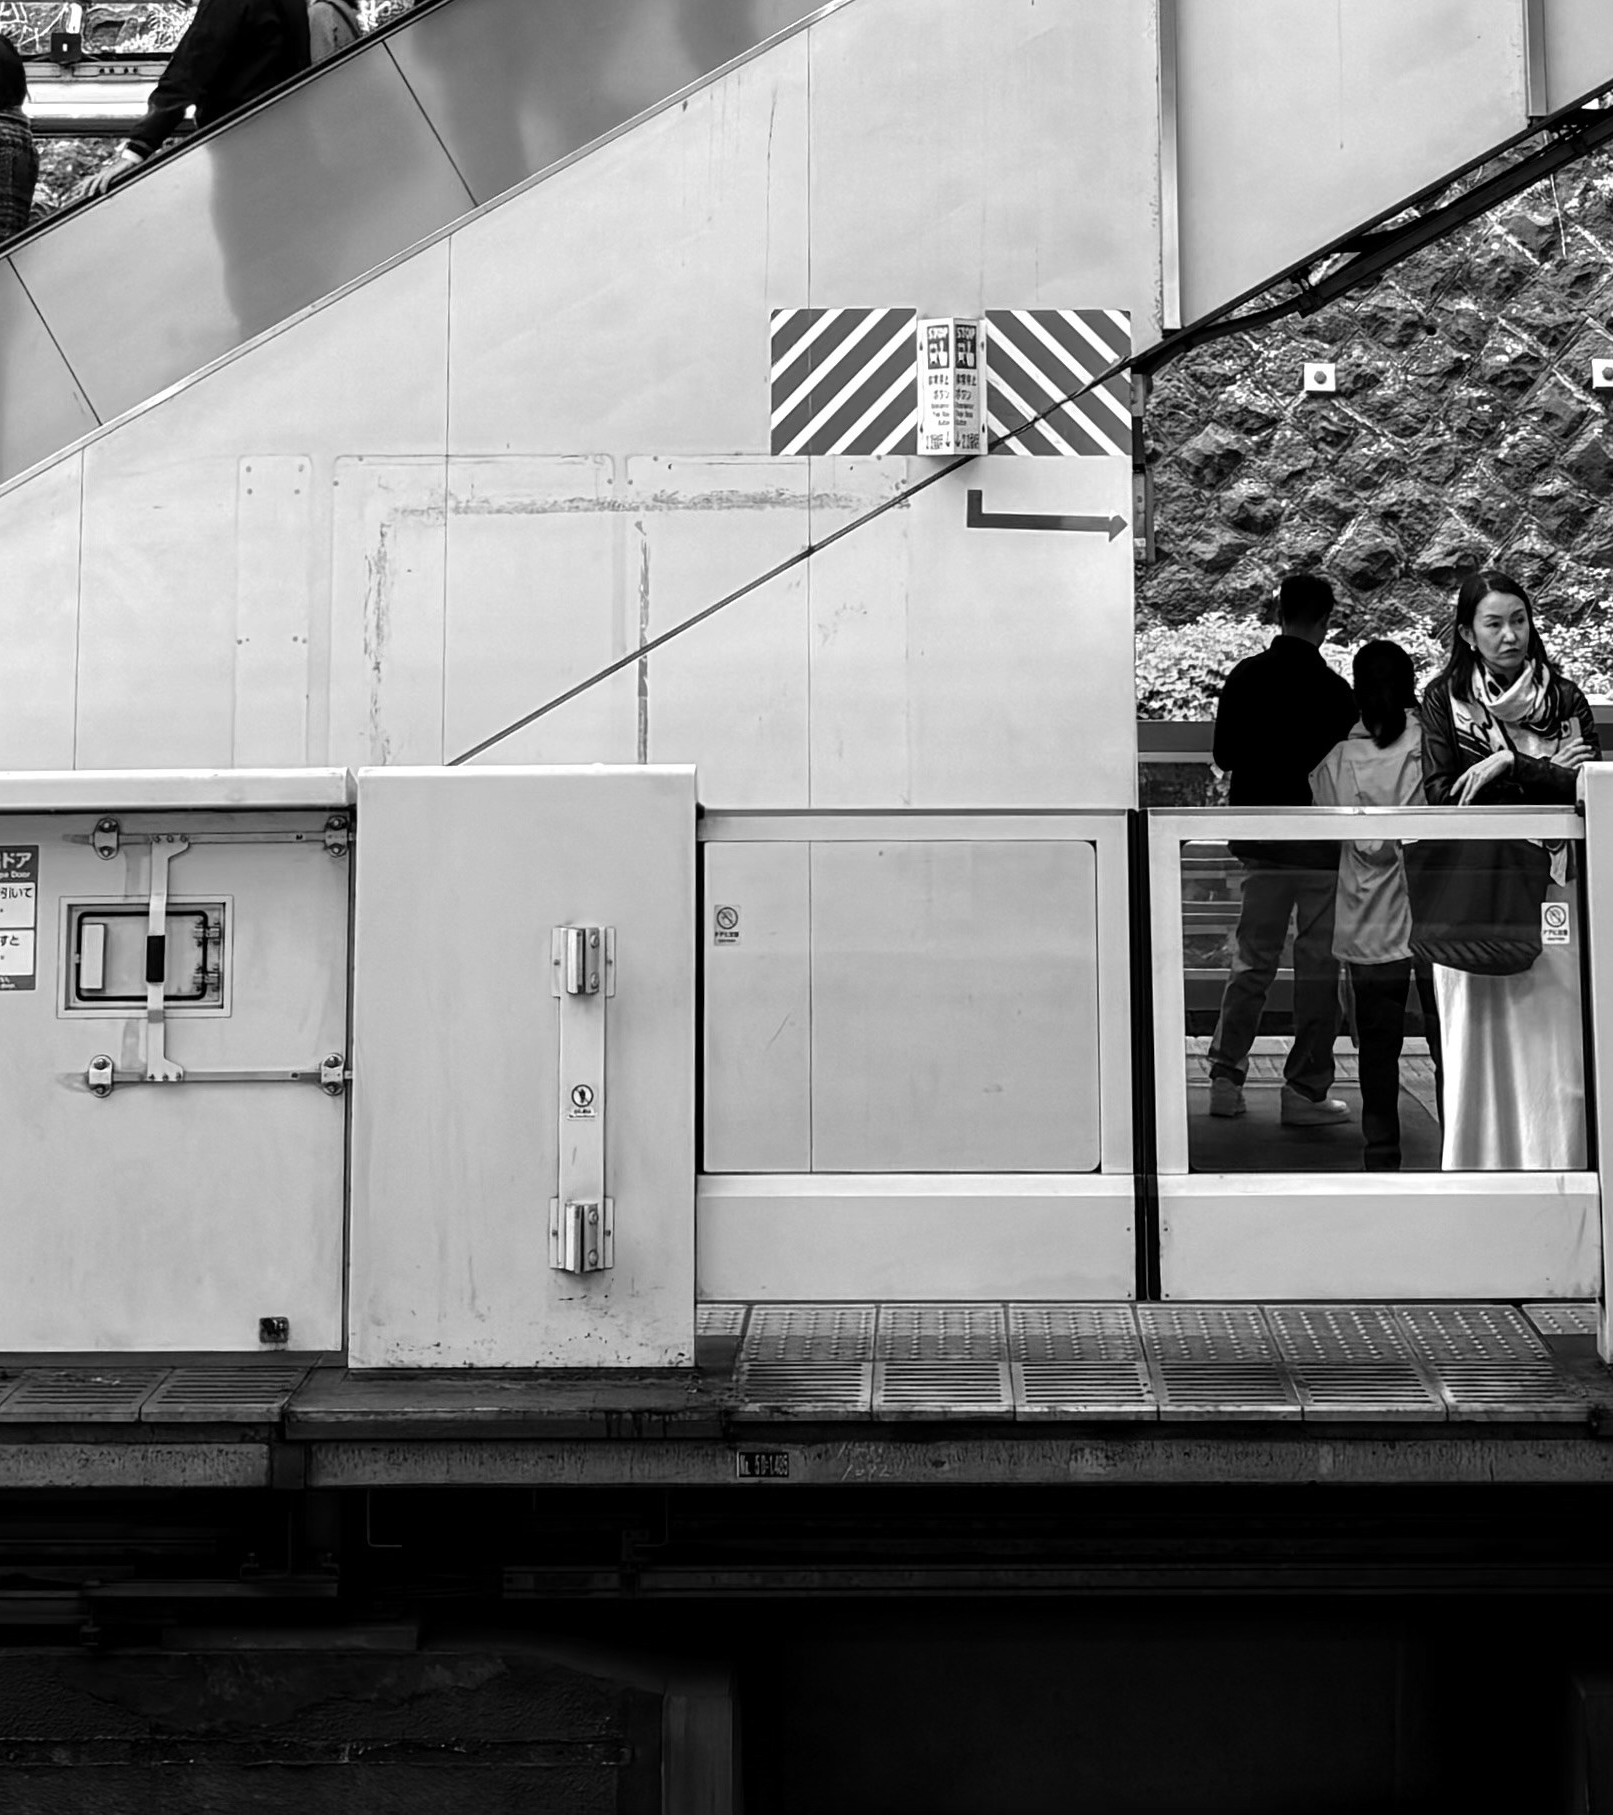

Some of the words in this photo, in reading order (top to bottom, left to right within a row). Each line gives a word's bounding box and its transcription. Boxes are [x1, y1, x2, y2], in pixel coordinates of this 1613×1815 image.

[928, 328, 948, 339] STOP
[956, 328, 975, 339] STOP
[11, 871, 31, 879] Door
